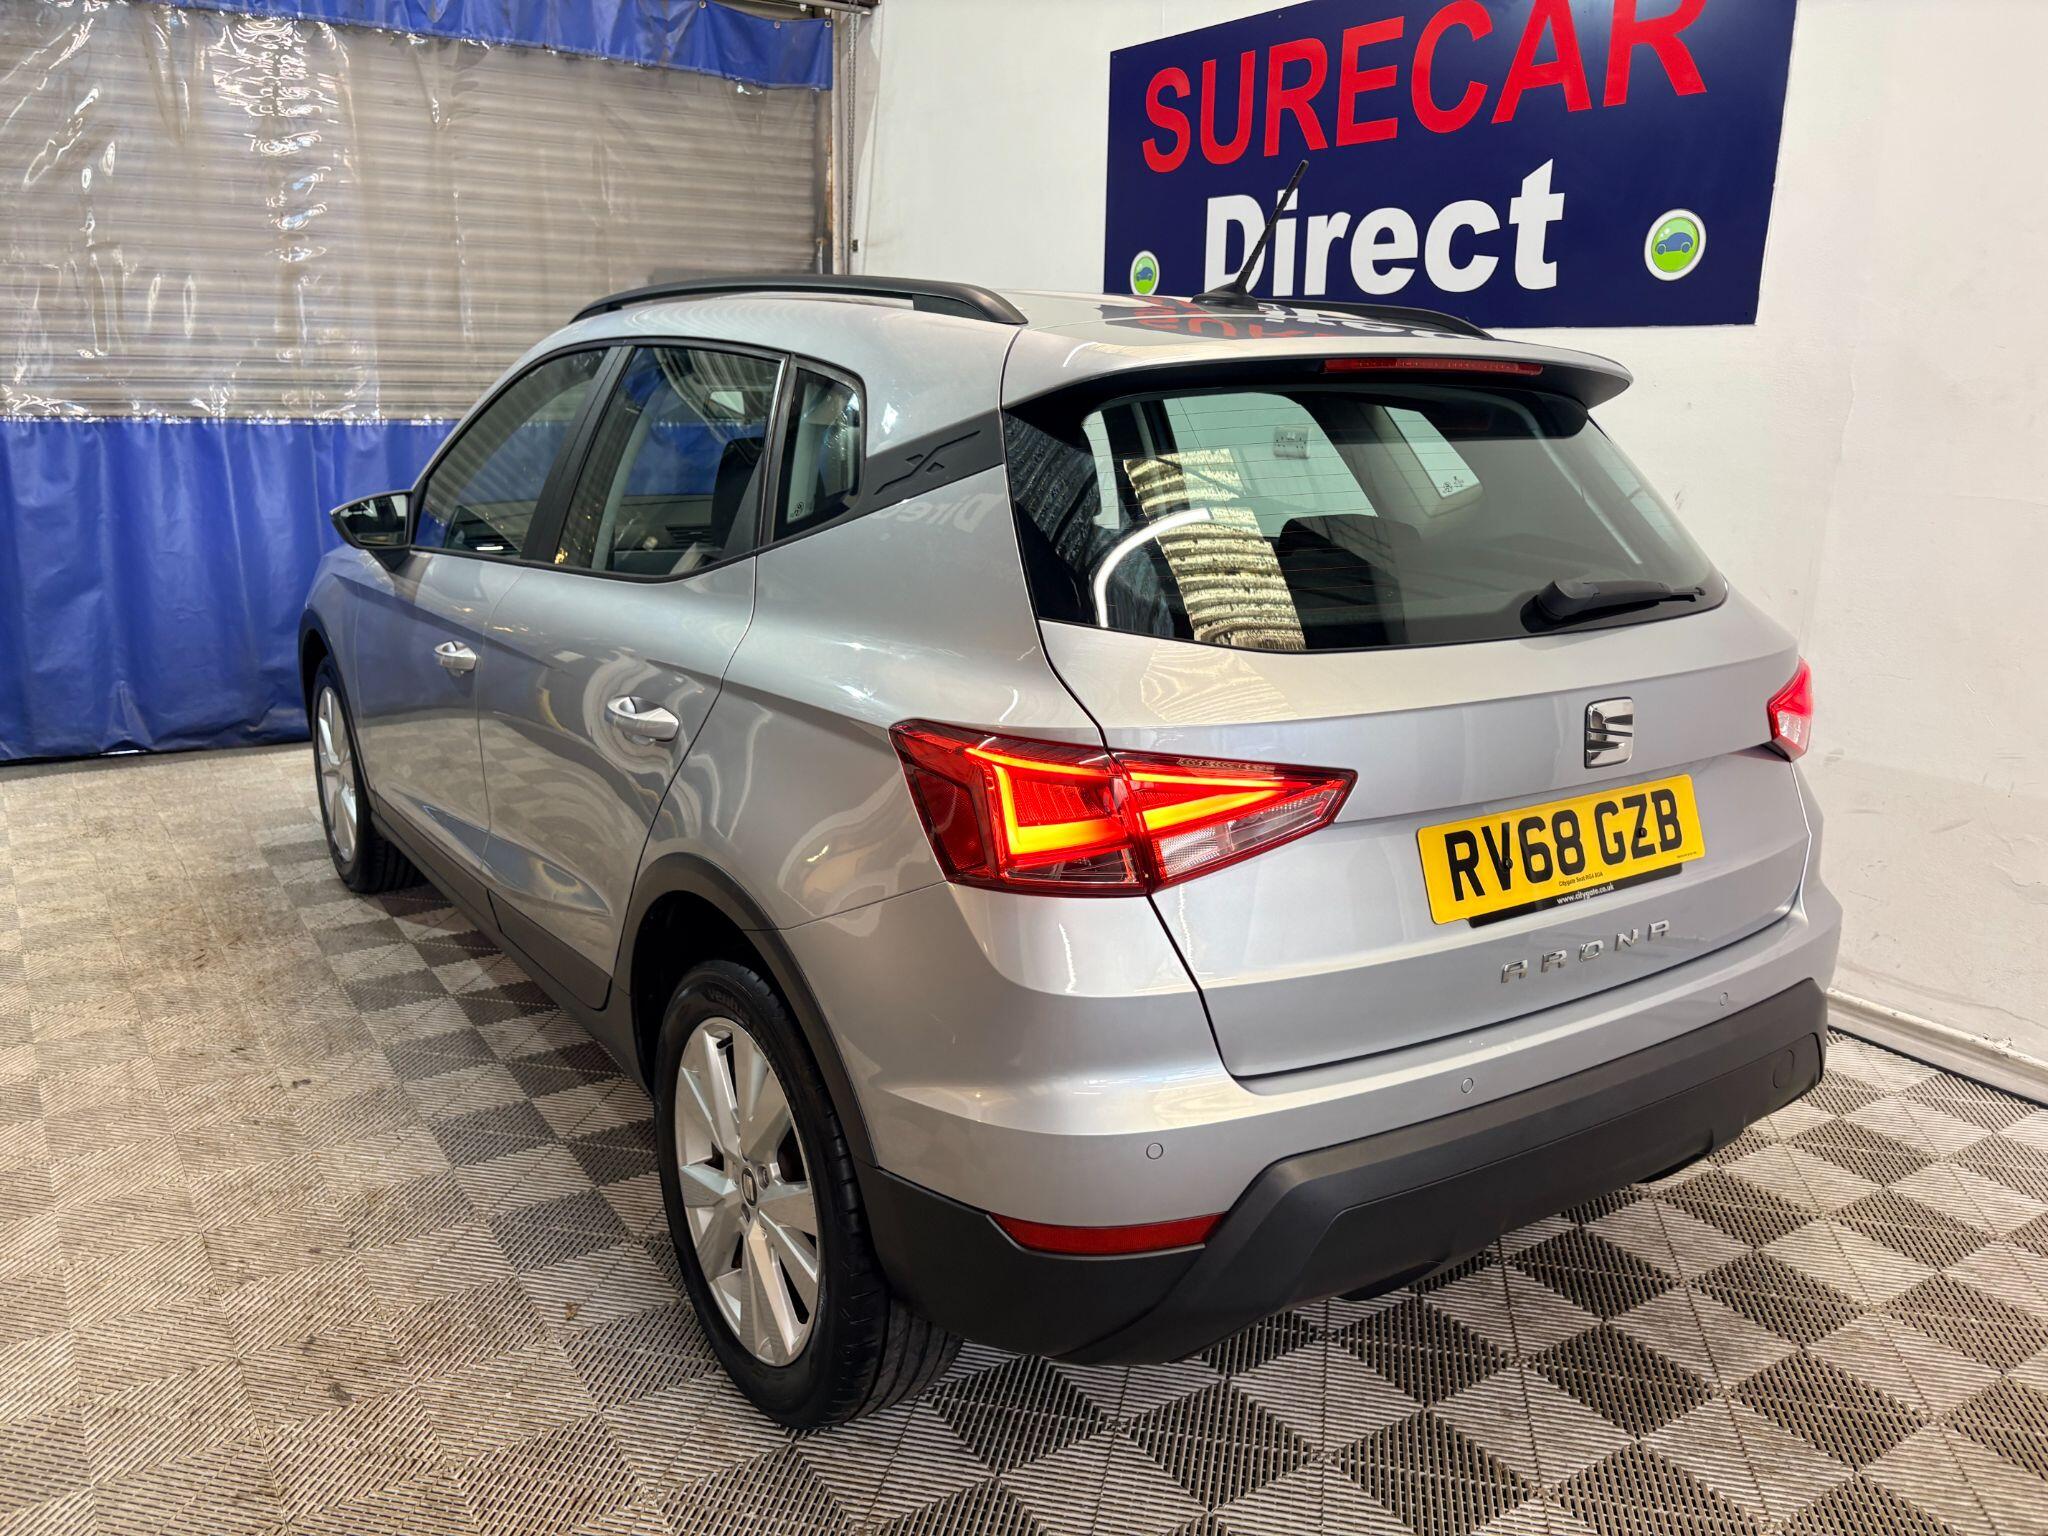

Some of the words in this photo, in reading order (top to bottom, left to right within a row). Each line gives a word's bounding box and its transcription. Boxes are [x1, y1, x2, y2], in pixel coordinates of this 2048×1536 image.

[1142, 0, 1707, 173] SURECAR
[1204, 159, 1565, 296] Direct
[1444, 809, 1586, 902] RV68
[1594, 788, 1683, 866] GZB
[1556, 883, 1615, 904] www.citygate.co.uk
[1501, 919, 1670, 983] ARONA
